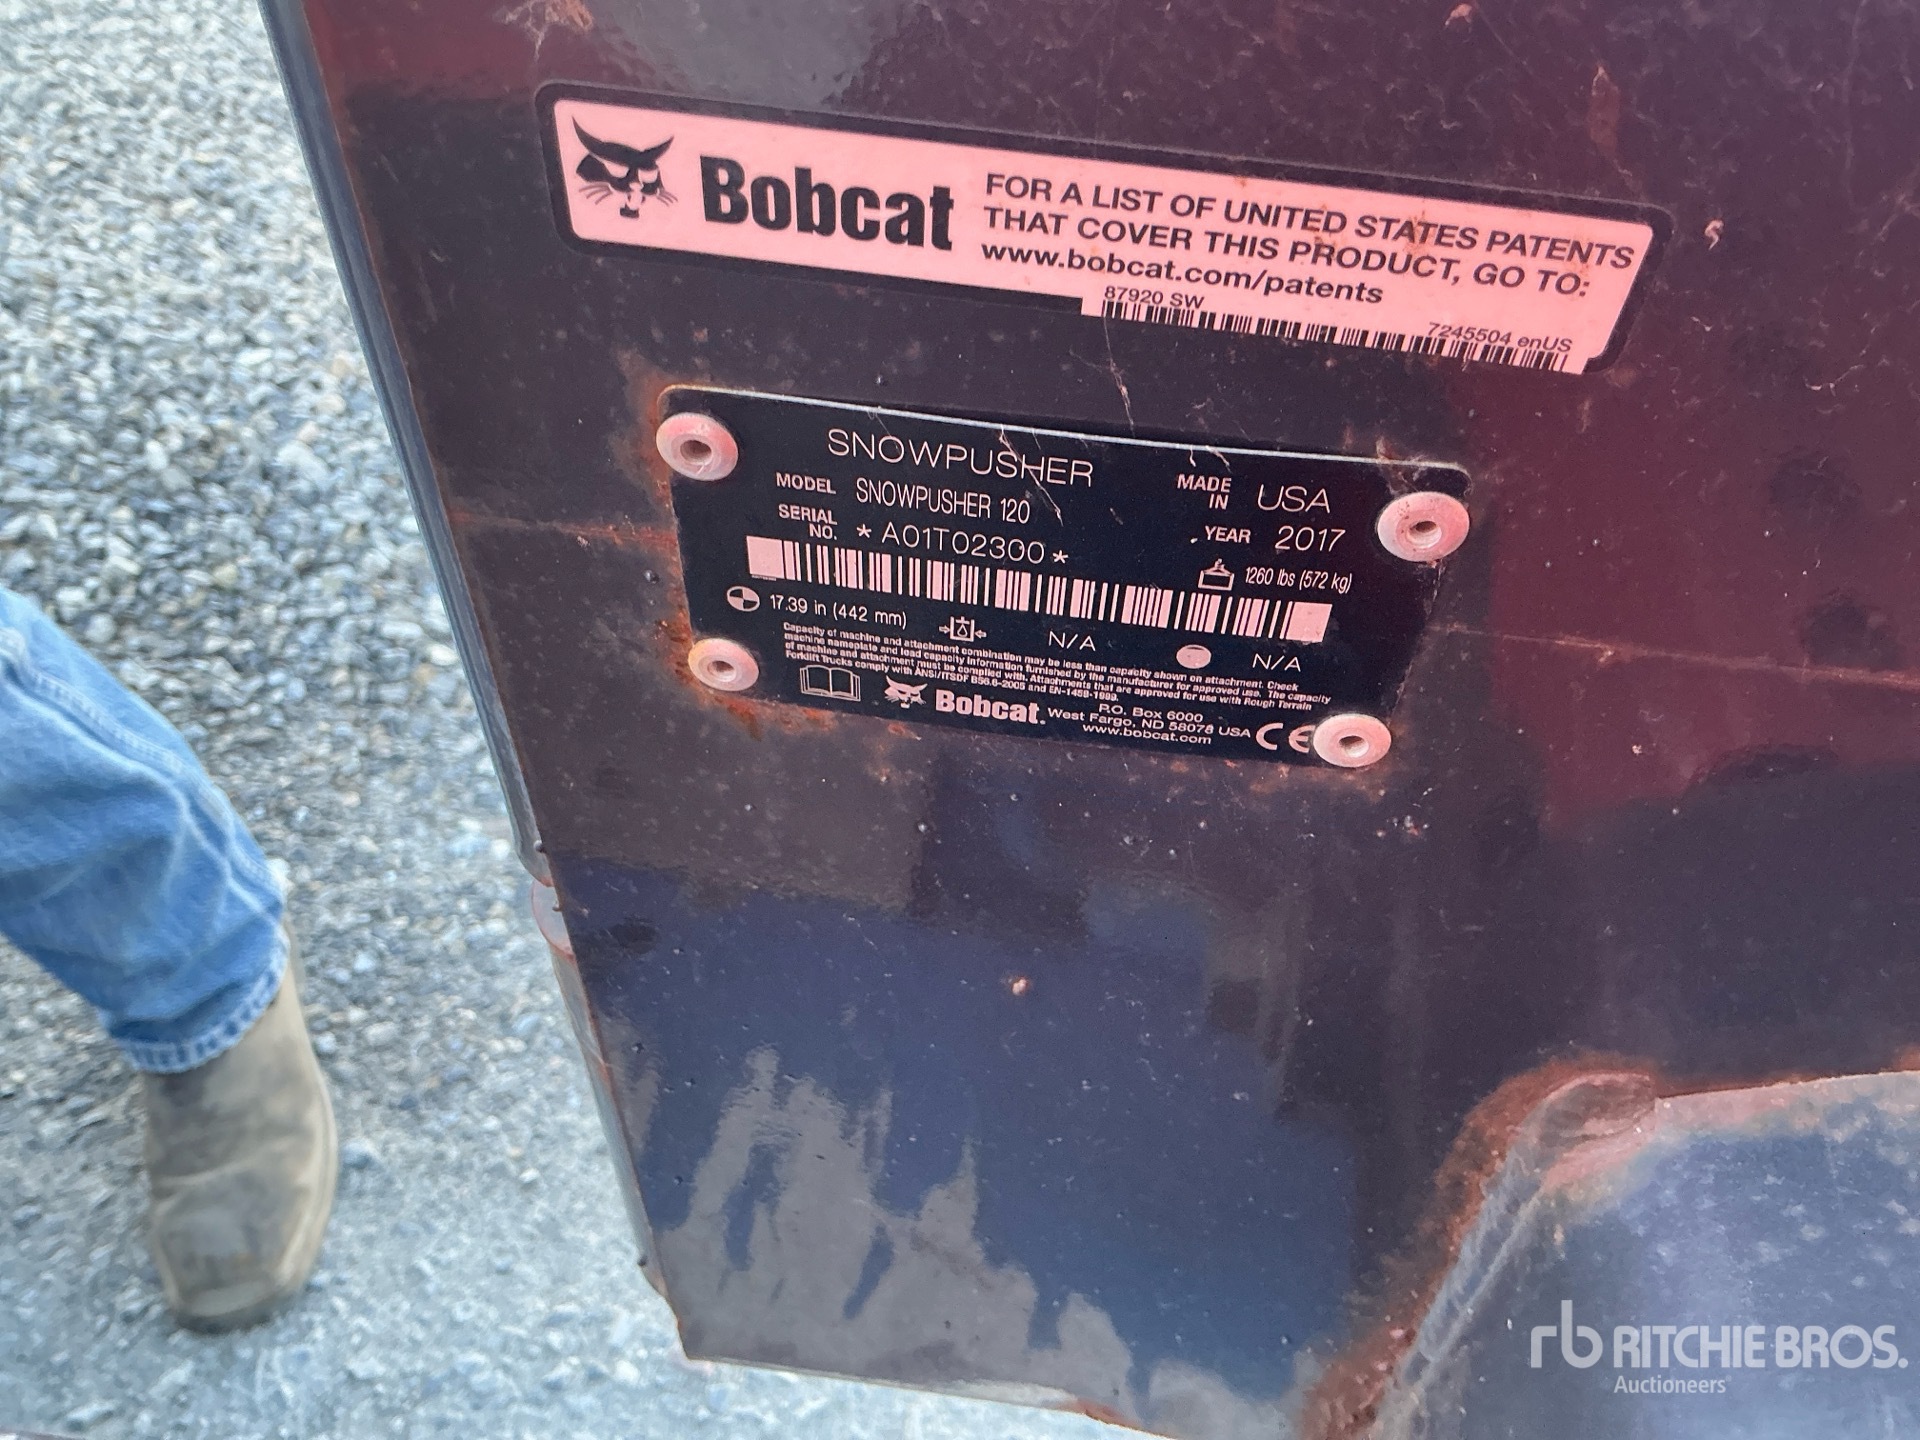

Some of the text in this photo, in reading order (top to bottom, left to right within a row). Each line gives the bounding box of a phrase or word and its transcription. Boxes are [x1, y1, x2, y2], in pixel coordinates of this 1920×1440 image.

[700, 154, 955, 251] Bobcat
[986, 173, 1635, 269] FOR A LIST OF UNITED STATES PATENTS
[983, 206, 1590, 297] THAT COVER THIS PRODUCT, GO TO:
[981, 243, 1384, 304] www.bobcat.com/patents
[1104, 286, 1204, 309] 87920 SW
[1428, 322, 1573, 353] 7245504 enUS
[828, 428, 1093, 487] SNOWPUSHER
[776, 472, 1030, 524] MODEL SNOWPUSHER 120
[1177, 474, 1232, 493] MADE
[1257, 484, 1330, 513] USA
[778, 504, 837, 526] SERIAL
[1208, 494, 1229, 510] IN
[809, 523, 838, 541] NO.
[1204, 525, 1346, 552] YEAR 2017
[1245, 566, 1352, 594] 1260 lbs (572 kg)
[769, 594, 907, 630] 17.39 in (442 mm)
[1048, 630, 1096, 652] N/A
[783, 622, 1299, 692] Capacity of machine and attachment combination may be less than capacity shown on attachment. Check
[784, 632, 825, 645] machine
[827, 638, 878, 653] nameplate
[880, 645, 898, 655] and
[900, 647, 921, 659] load
[923, 650, 965, 664] capacity
[967, 656, 1023, 671] information
[1025, 664, 1071, 679] furnished
[1074, 669, 1087, 680] by
[1089, 672, 1104, 682] the
[1107, 675, 1173, 690] manufacturer
[1176, 680, 1191, 690] for
[1193, 683, 1239, 697] approved
[1268, 690, 1285, 700] The
[1288, 692, 1331, 706] capacity
[786, 650, 820, 662] Forklift
[821, 654, 852, 667] Trucks
[855, 661, 889, 673] comply
[892, 665, 912, 675] with
[1028, 683, 1046, 692] and
[1252, 653, 1301, 672] N/A
[785, 641, 795, 650] of
[797, 643, 838, 656] machine
[840, 650, 858, 659] and
[860, 652, 914, 667] attachment
[917, 660, 941, 671] must
[944, 662, 956, 672] be
[958, 665, 1001, 679] complied
[1030, 675, 1092, 690] Attachments
[1094, 682, 1113, 692] that
[1116, 686, 1131, 694] are
[1134, 688, 1180, 701] approved
[1183, 691, 1198, 700] for
[1199, 694, 1217, 703] use
[1220, 695, 1241, 705] with
[1244, 698, 1275, 710] Rough
[1278, 700, 1312, 711] Terrain
[1048, 707, 1085, 721] West
[1142, 718, 1164, 730] ND
[1169, 722, 1213, 735] 58078
[1219, 727, 1250, 738] USA
[1099, 703, 1203, 722] P.O. Box 6000
[1083, 724, 1211, 745] www.bobcat.com
